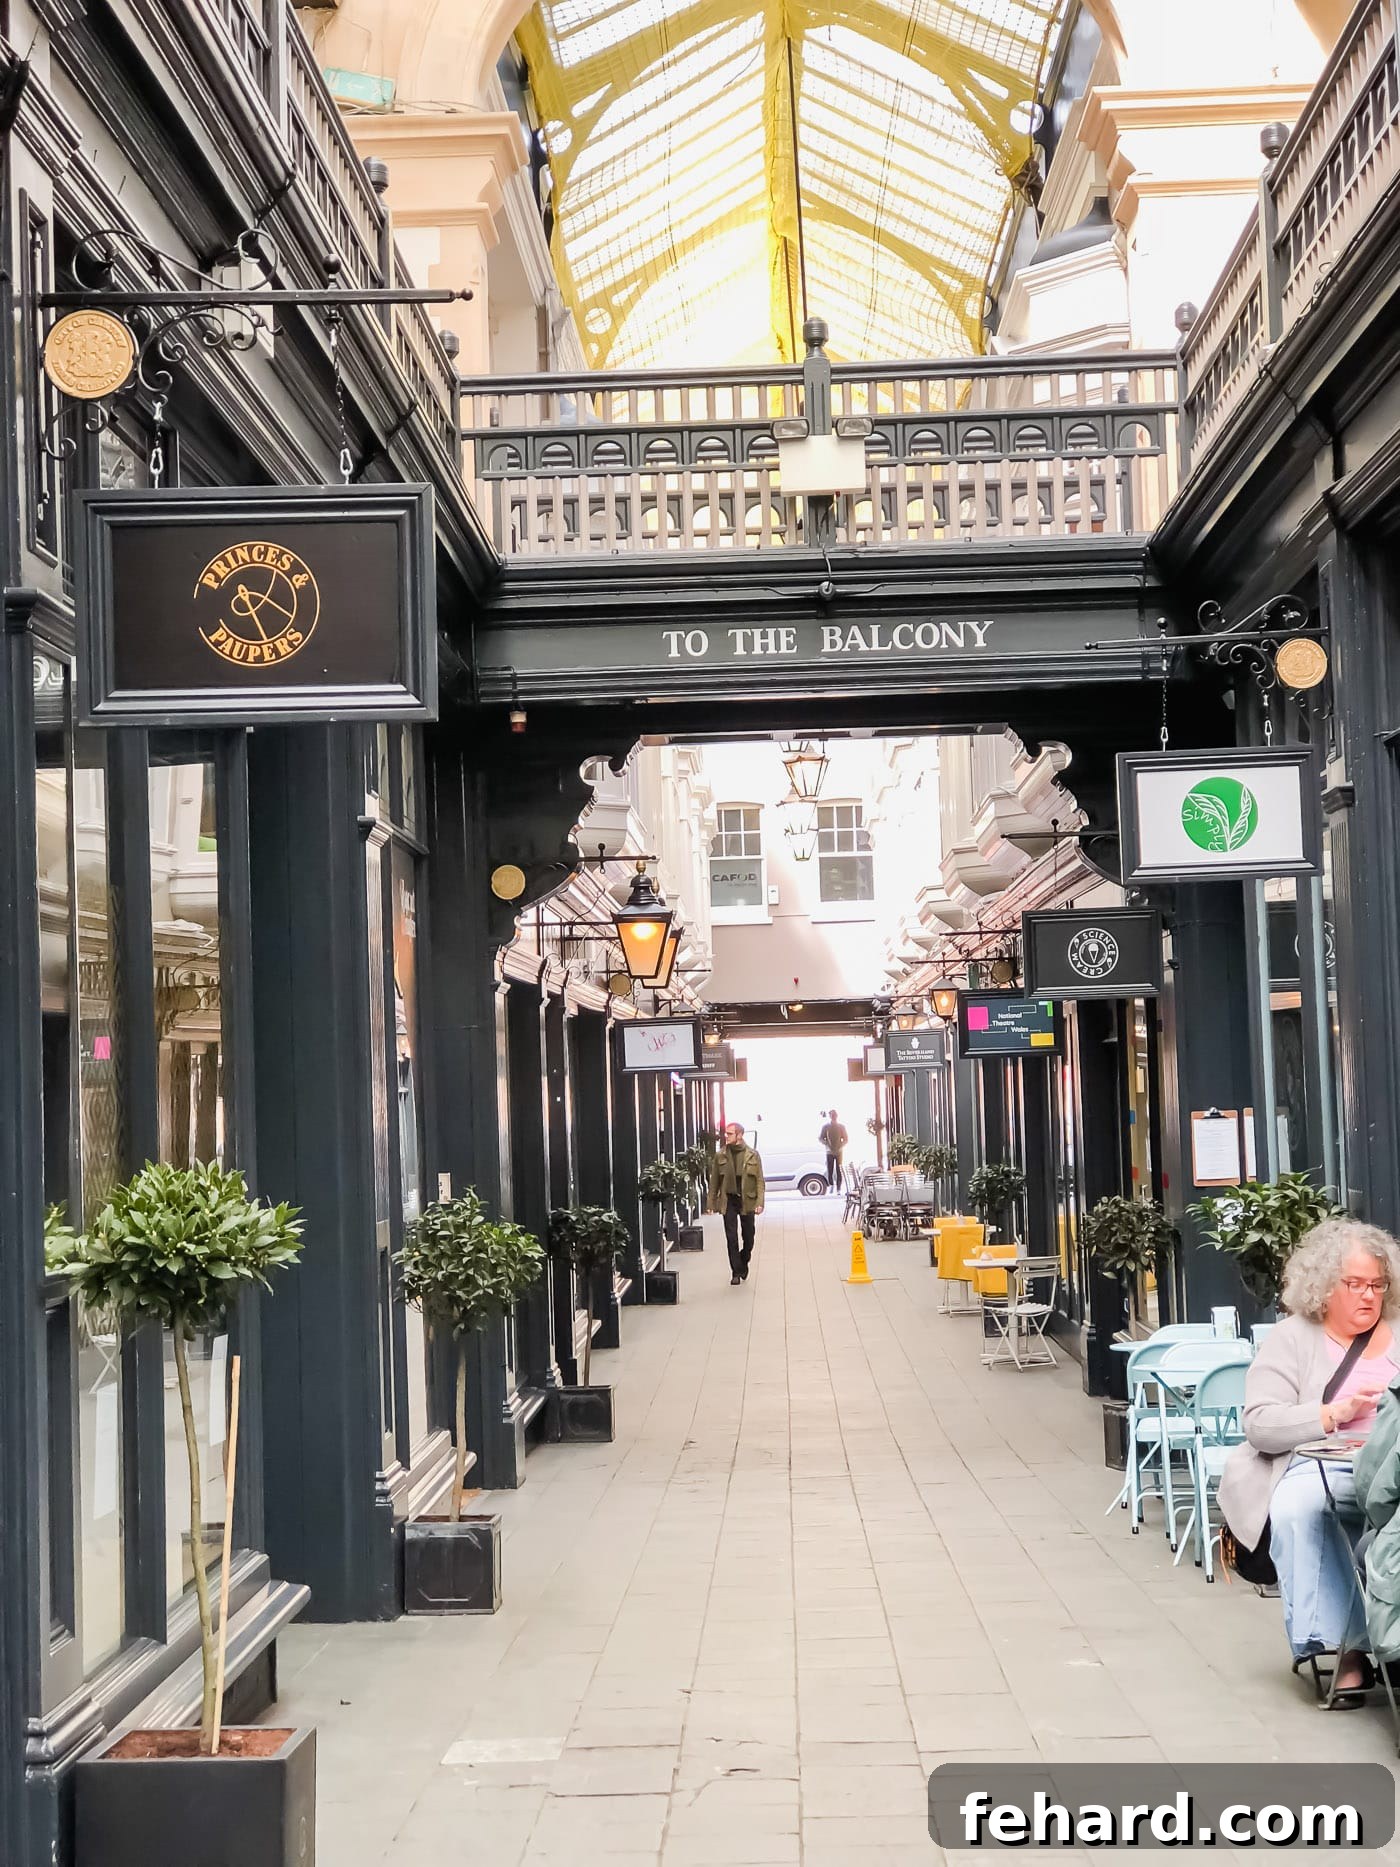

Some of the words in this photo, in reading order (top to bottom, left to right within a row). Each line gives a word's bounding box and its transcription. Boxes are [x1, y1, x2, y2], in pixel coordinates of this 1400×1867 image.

[201, 544, 295, 590] PRINCES
[292, 573, 310, 590] &
[208, 627, 304, 662] PAUPERS
[662, 629, 710, 658] TO
[727, 626, 798, 655] THE
[820, 620, 994, 653] BALCONY
[712, 874, 757, 882] CAFOD
[1082, 930, 1116, 956] SCIENCE
[1071, 952, 1104, 976] CREAM
